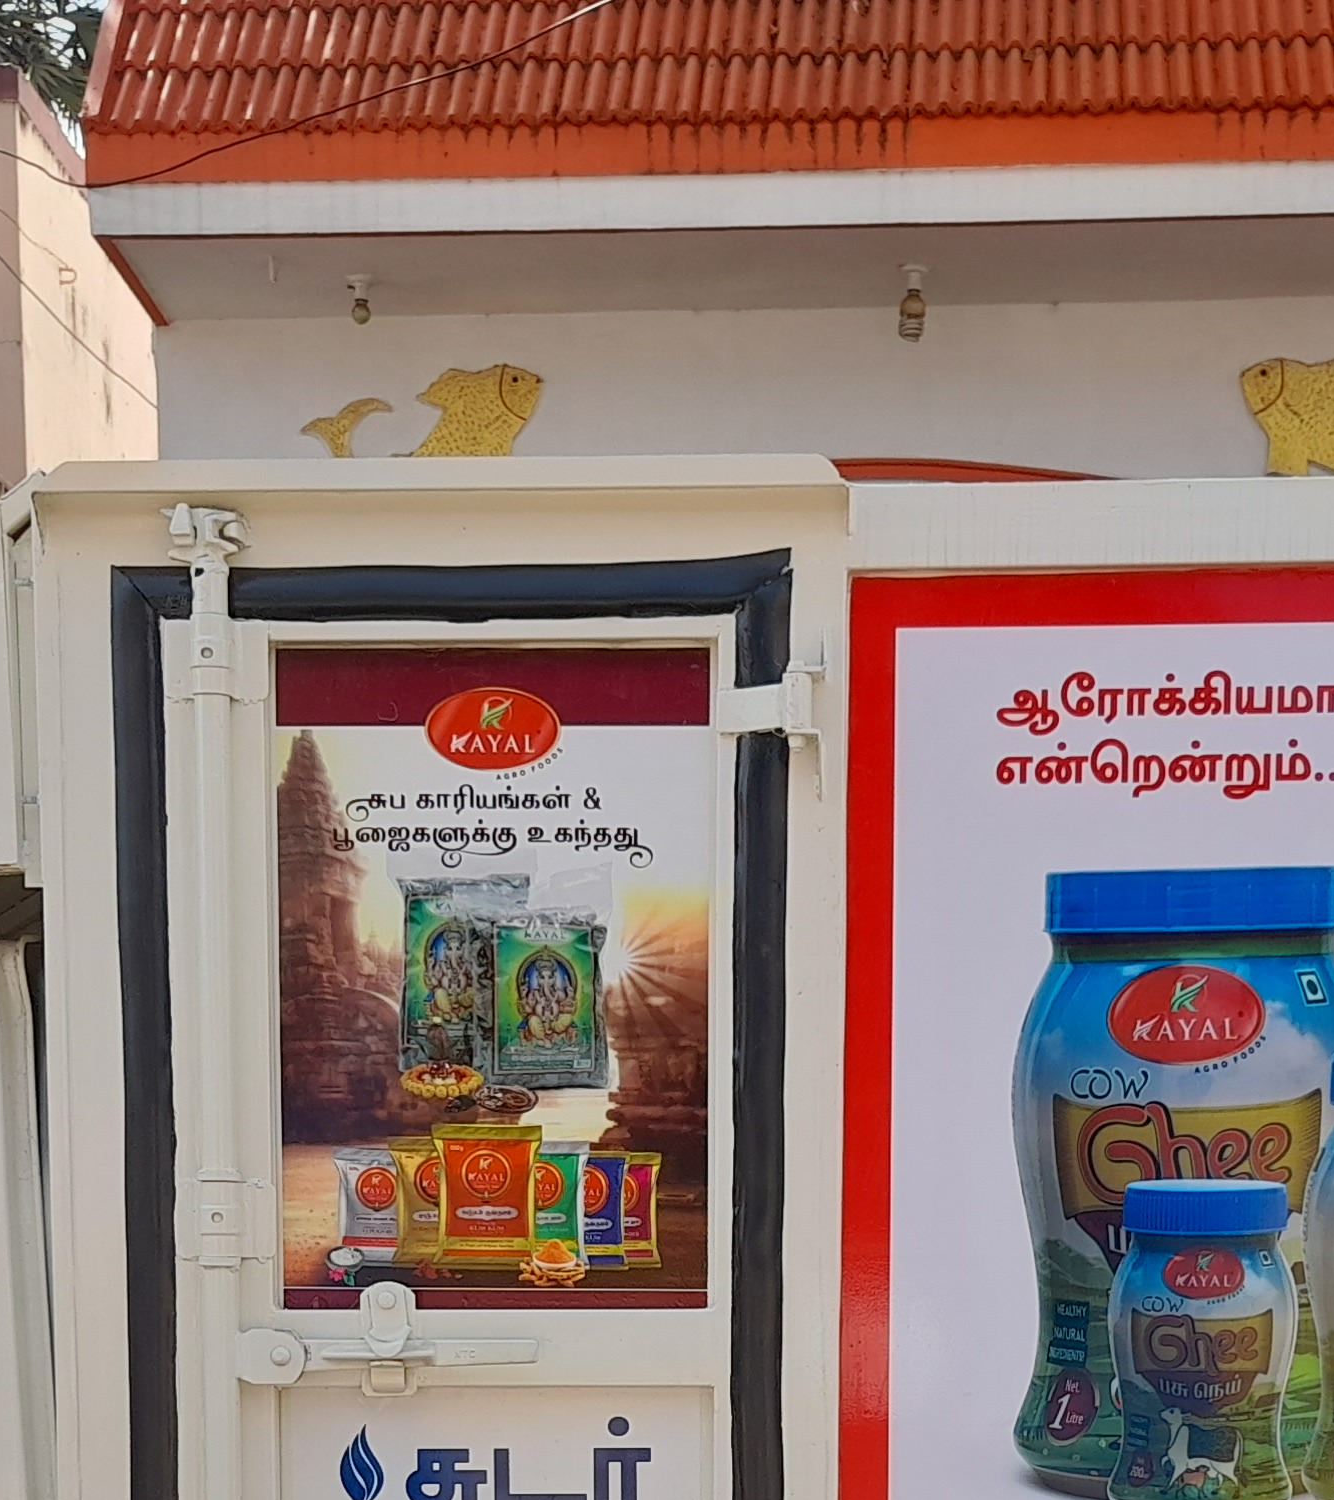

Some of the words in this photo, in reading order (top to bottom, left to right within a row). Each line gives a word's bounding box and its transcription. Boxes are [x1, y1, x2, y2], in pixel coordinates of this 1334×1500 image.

[450, 731, 536, 754] KAYAL
[496, 769, 526, 781] AGRO
[531, 747, 563, 773] FOODS
[346, 788, 406, 821] சுப
[416, 784, 572, 815] காரியங்கள்
[584, 788, 602, 810] &
[333, 820, 517, 868] பூஜைகளுக்கு
[528, 820, 654, 868] உகந்தது
[1132, 1015, 1238, 1042] KAYAL
[1194, 1059, 1228, 1075] AGRO
[1233, 1034, 1267, 1065] FOODS
[1070, 1068, 1149, 1100] COW
[1077, 1101, 1293, 1206] Ghee
[468, 1172, 505, 1182] KAYAL
[1175, 1273, 1233, 1288] KAYAL
[1142, 1296, 1184, 1313] COW
[1145, 1313, 1259, 1377] Ghee
[1158, 1378, 1188, 1398] பசு
[1193, 1373, 1242, 1401] நெய்
